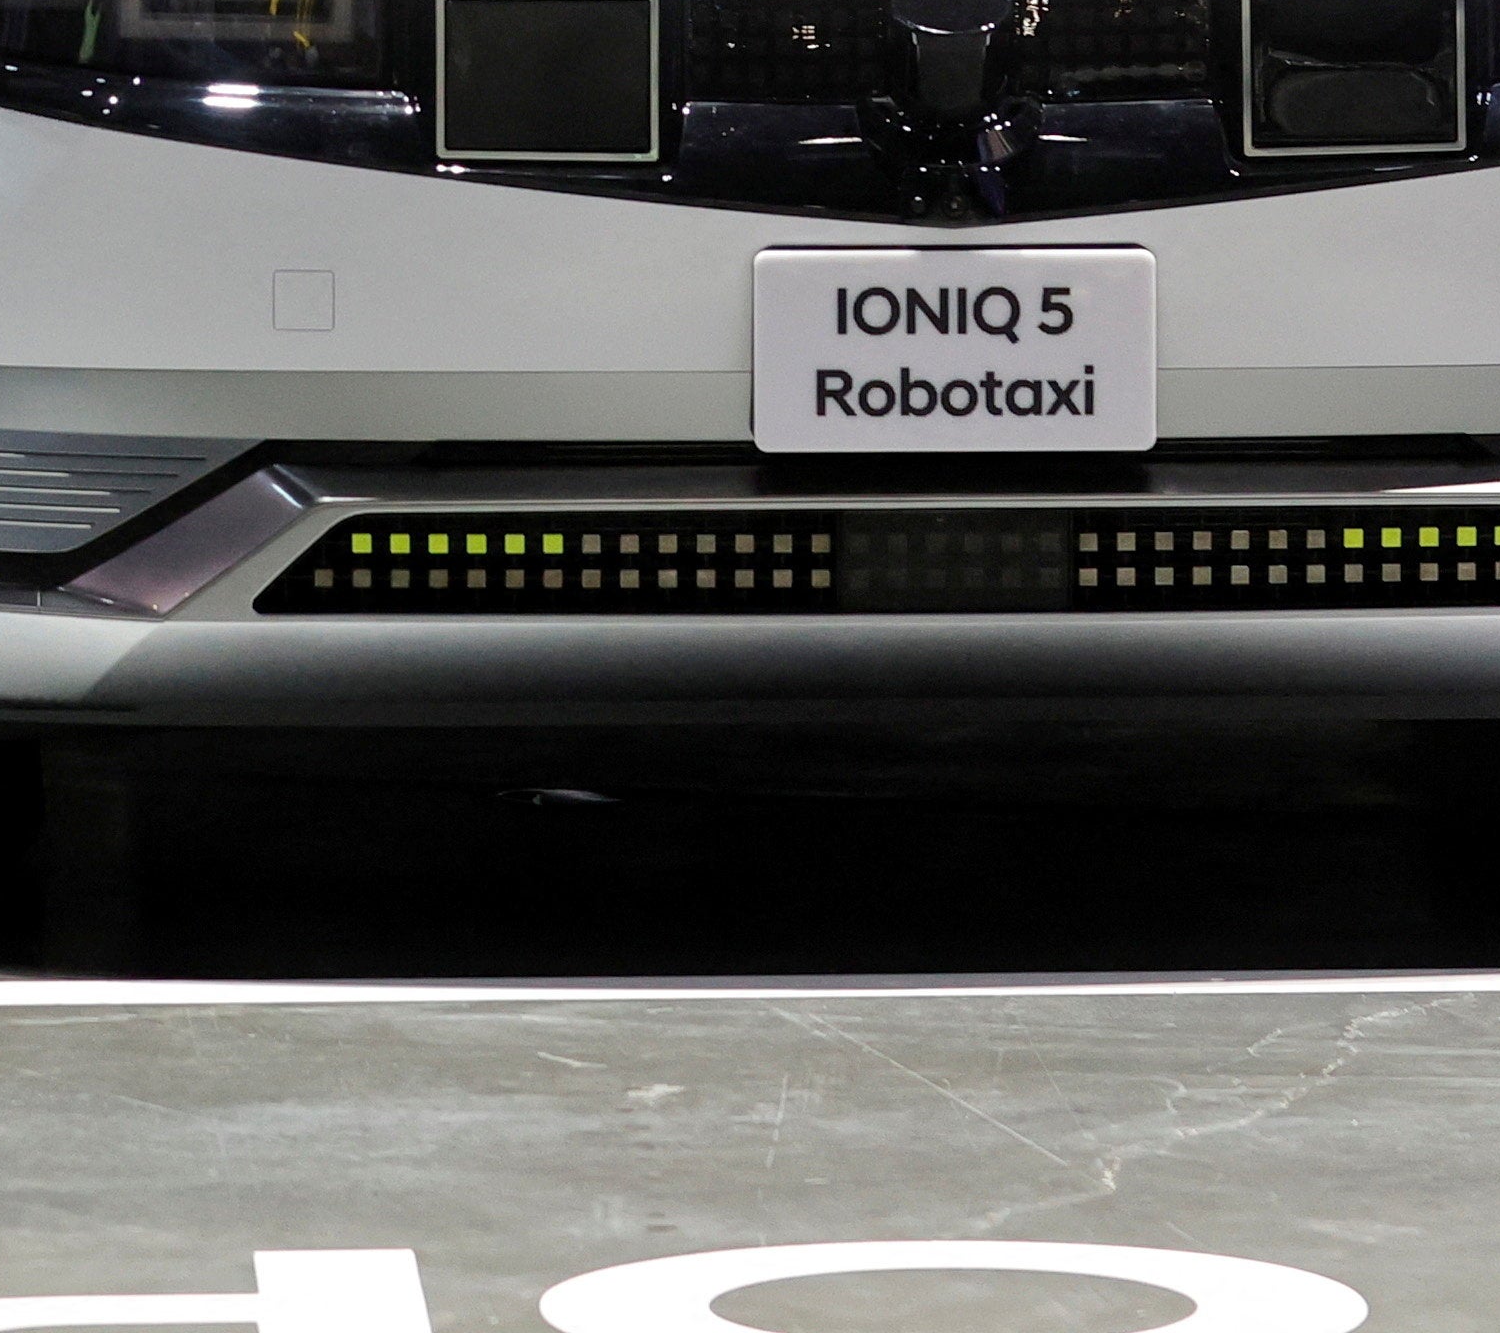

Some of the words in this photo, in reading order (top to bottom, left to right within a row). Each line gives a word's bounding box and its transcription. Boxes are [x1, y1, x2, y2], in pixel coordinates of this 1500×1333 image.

[836, 286, 1022, 344] IONIQ
[1037, 286, 1073, 335] 5
[815, 364, 1095, 417] Robotaxi
